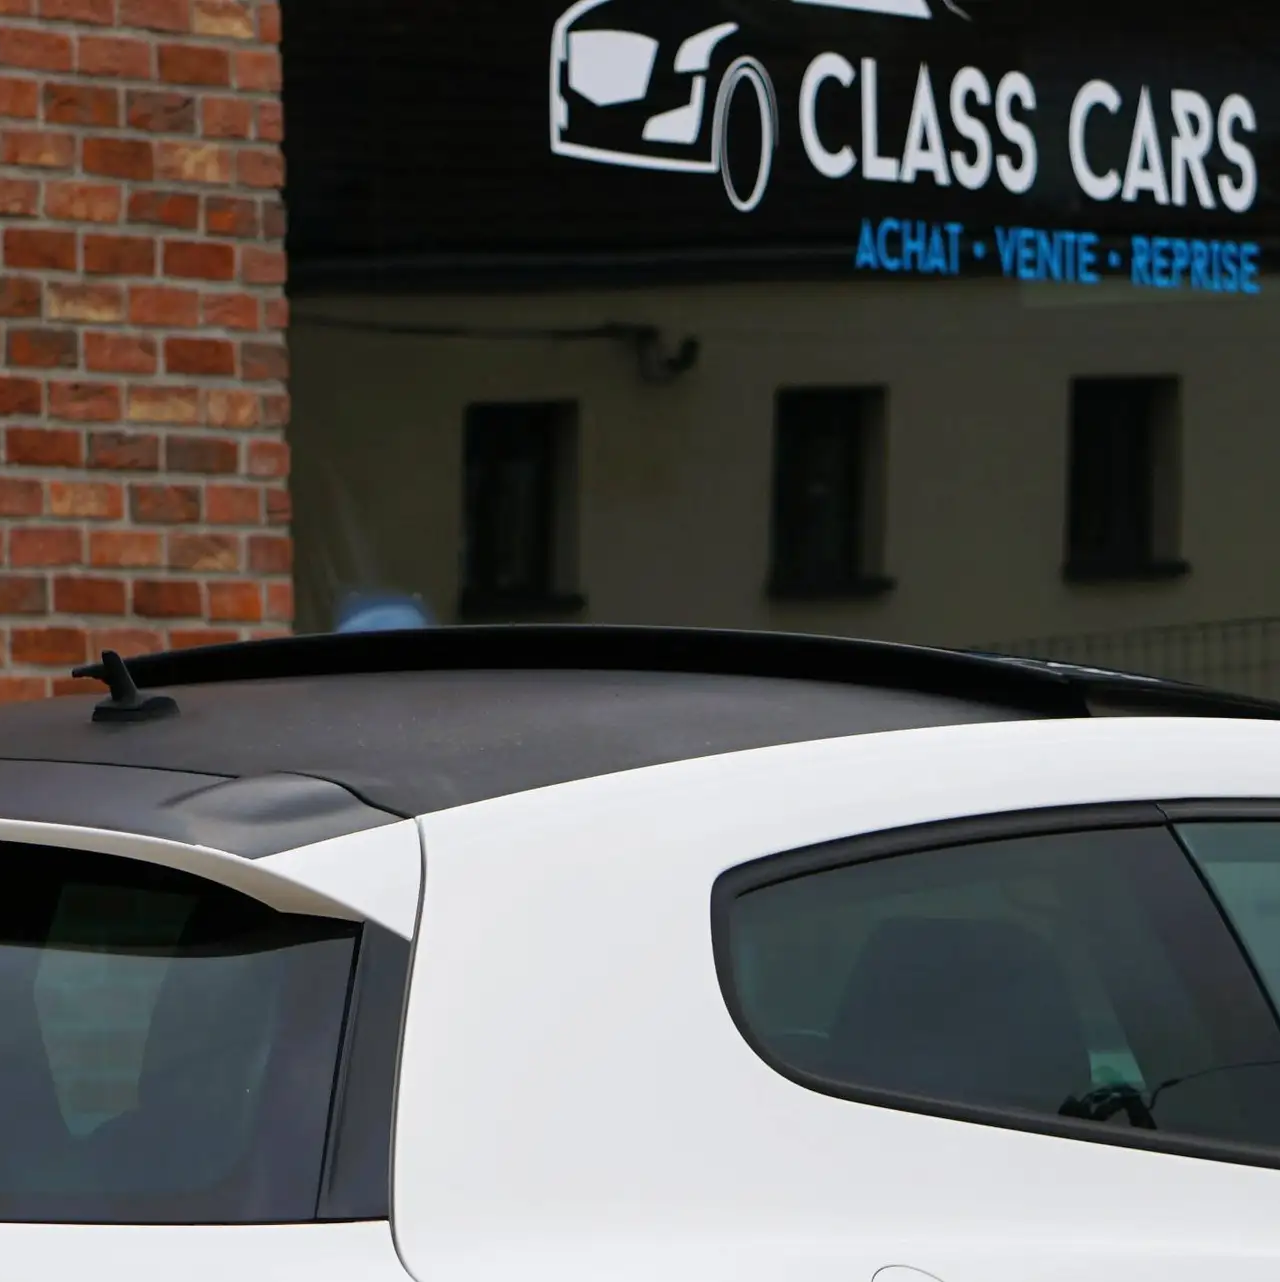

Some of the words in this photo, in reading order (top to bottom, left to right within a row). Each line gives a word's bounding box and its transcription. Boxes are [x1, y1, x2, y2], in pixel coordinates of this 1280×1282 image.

[798, 52, 1037, 193] CLASS
[1068, 79, 1257, 212] CARS
[854, 217, 963, 274] ACHAT
[994, 226, 1101, 285] VENTE
[1130, 235, 1261, 295] REPRISE
